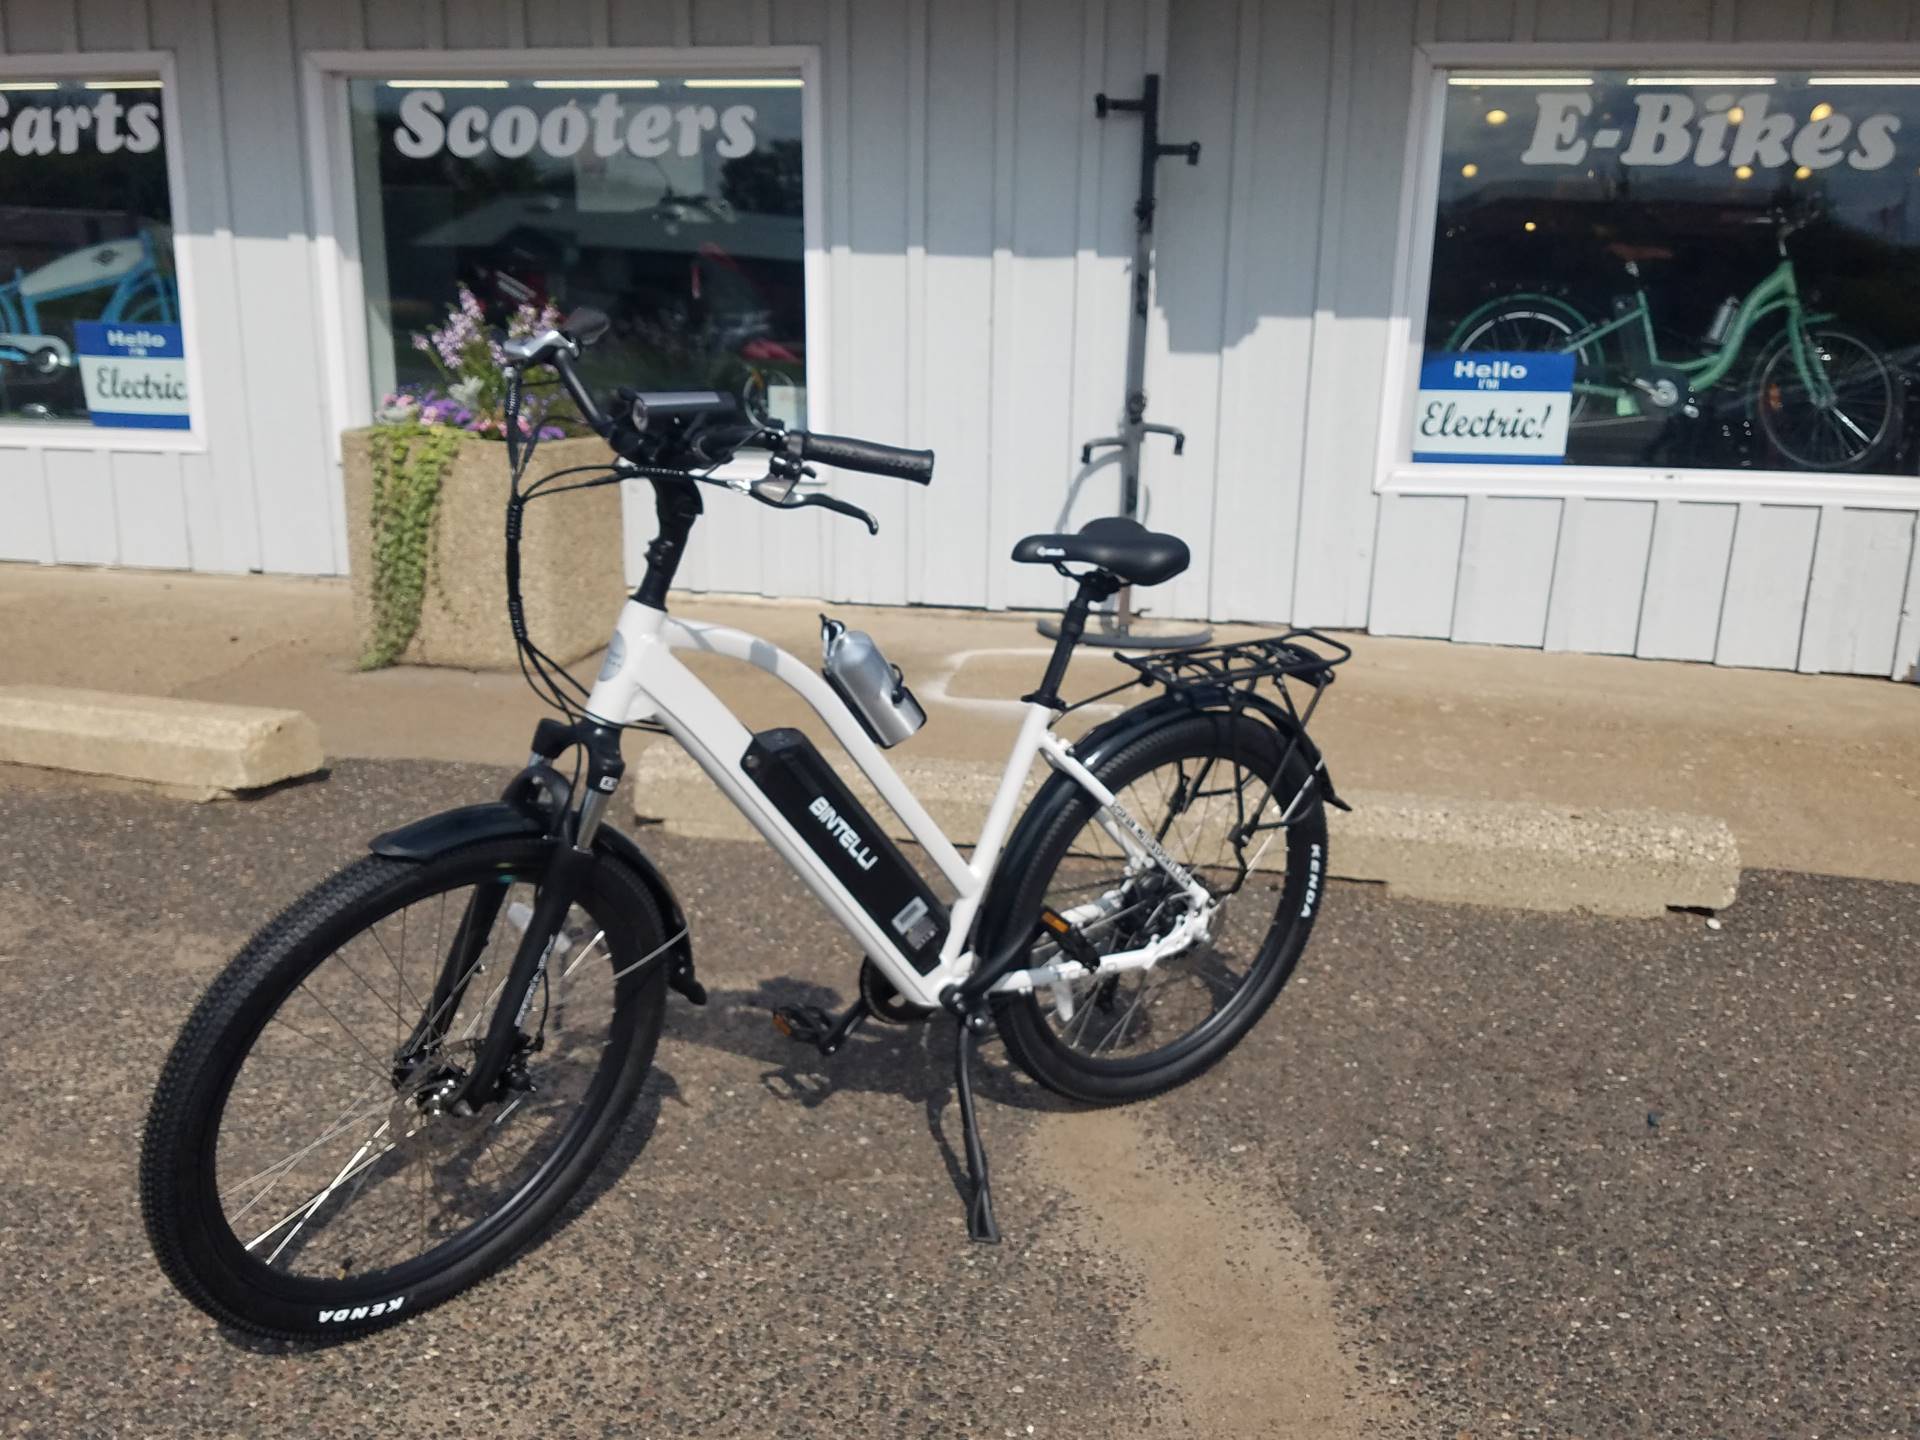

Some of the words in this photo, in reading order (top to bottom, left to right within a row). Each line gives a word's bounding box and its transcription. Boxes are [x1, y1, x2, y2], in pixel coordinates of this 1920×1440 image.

[0, 91, 161, 157] arts
[393, 89, 758, 159] Scooters
[1520, 92, 1901, 170] E-Bikes
[106, 329, 166, 348] Hello
[1453, 360, 1529, 379] Hello
[1421, 400, 1552, 439] Electric!
[808, 795, 879, 871] BINTELLI
[1300, 843, 1321, 918] KENDA
[318, 1295, 405, 1323] KENDA
